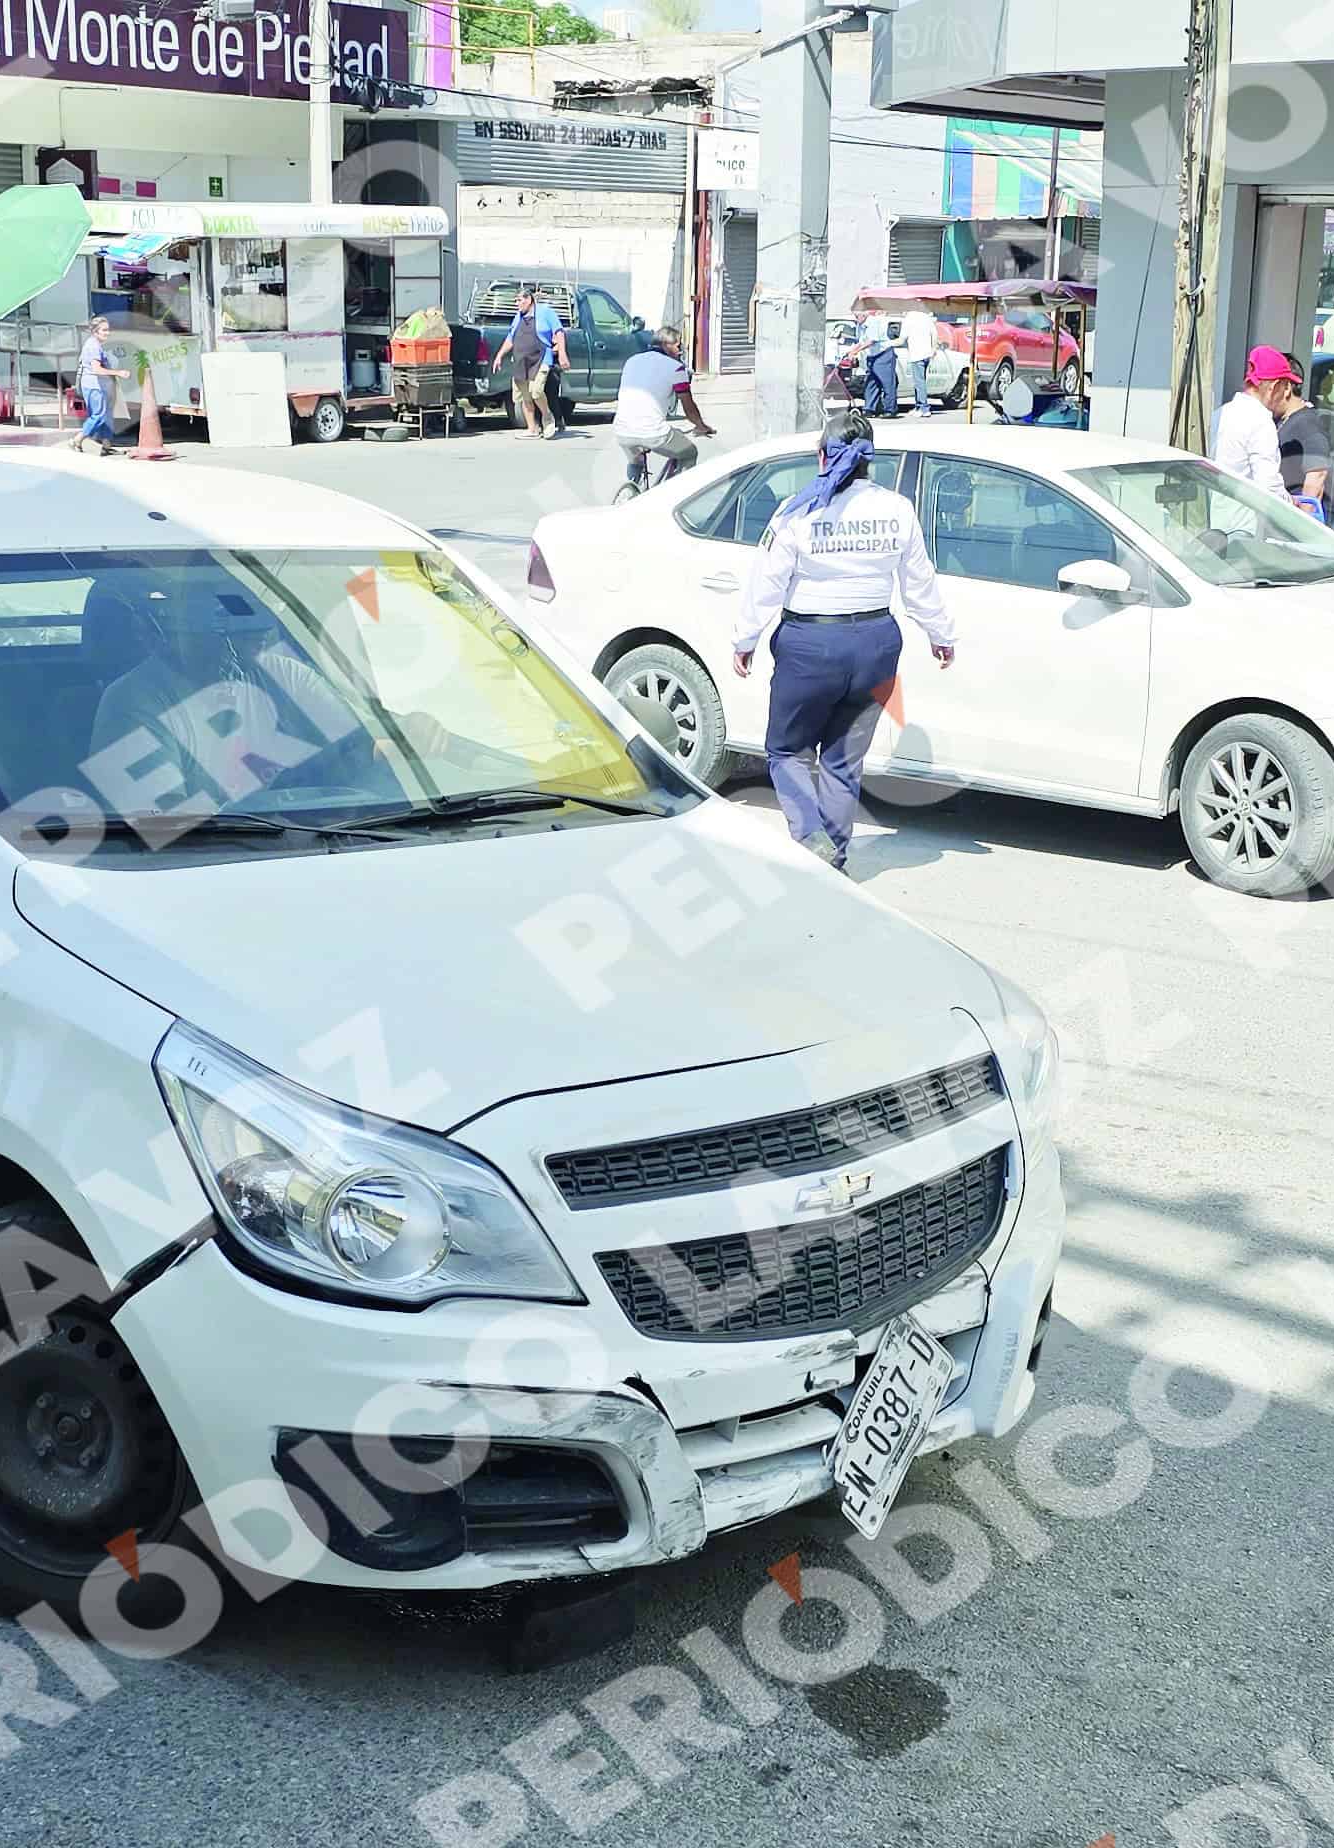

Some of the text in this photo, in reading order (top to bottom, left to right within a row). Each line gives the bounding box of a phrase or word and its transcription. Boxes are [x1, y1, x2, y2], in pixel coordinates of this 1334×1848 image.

[25, 0, 180, 72] Monte
[192, 18, 244, 78] de
[474, 121, 494, 138] EN
[498, 121, 556, 143] SERVICIO
[559, 123, 577, 144] 24
[639, 130, 667, 150] DIAS
[810, 537, 900, 555] MUNICIPAL
[844, 1364, 888, 1443] COAHUILA
